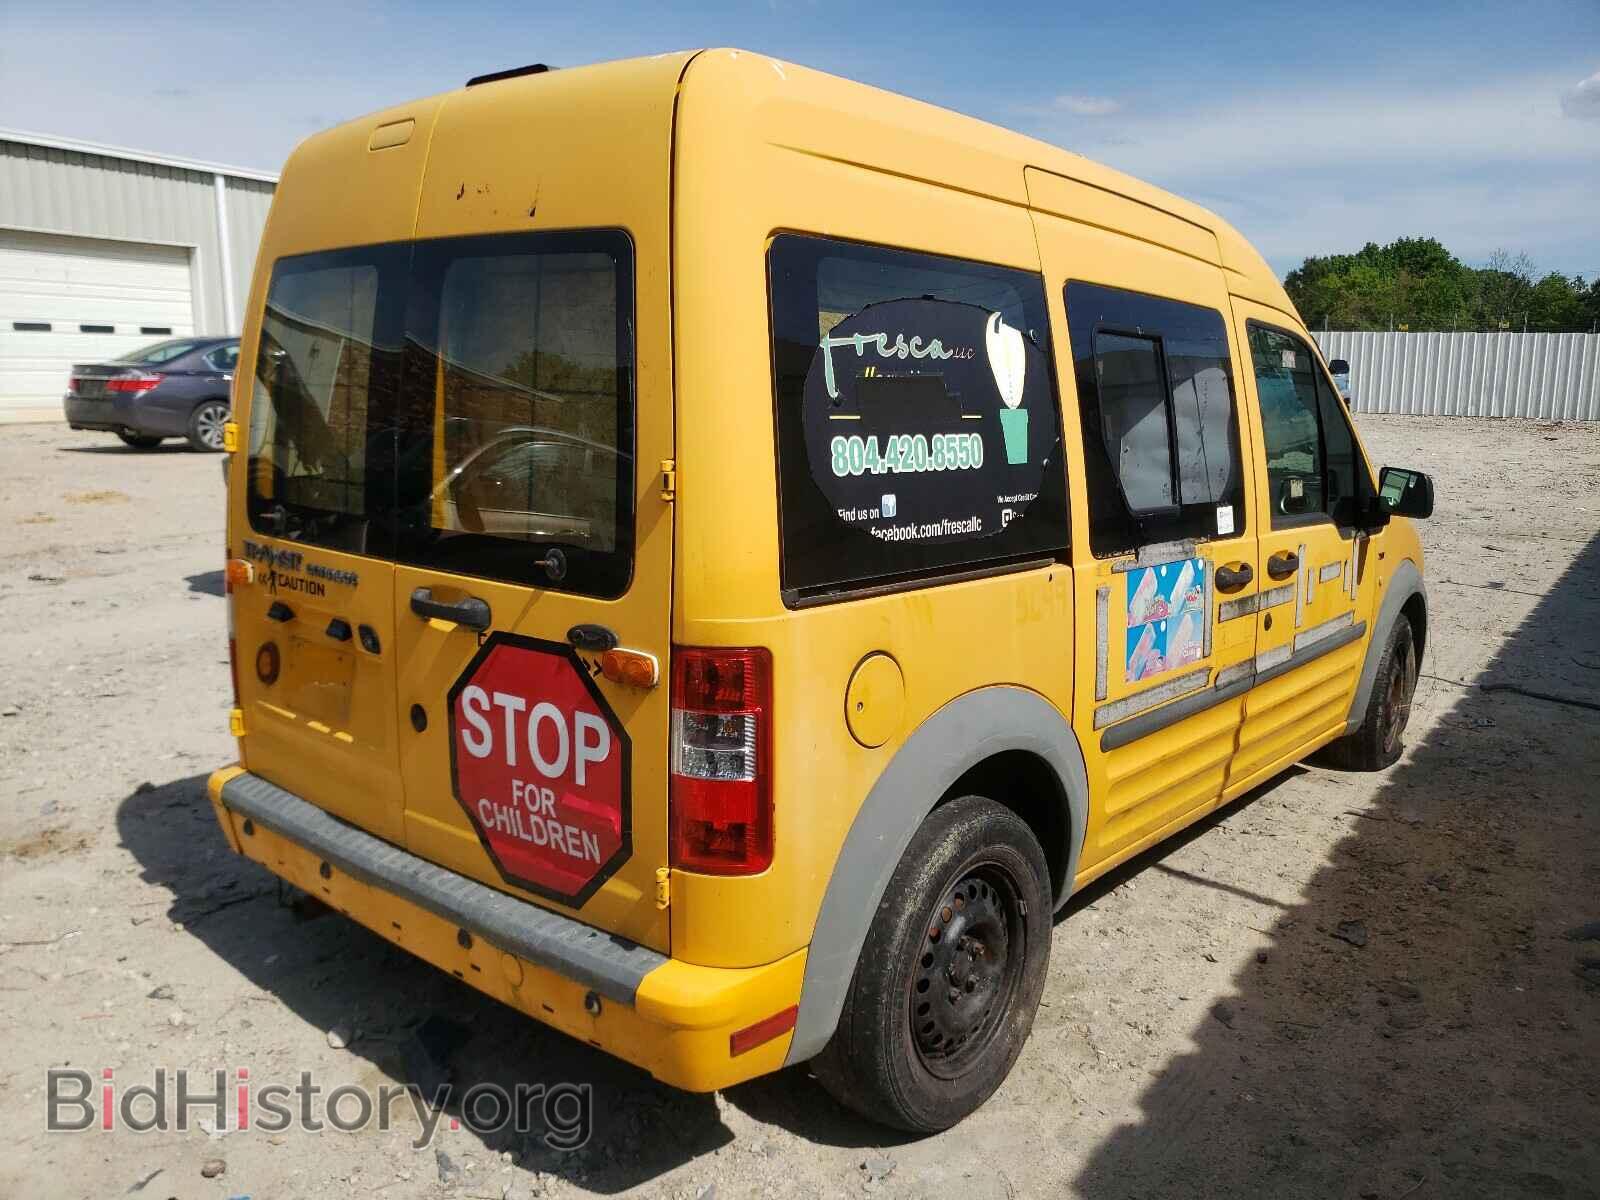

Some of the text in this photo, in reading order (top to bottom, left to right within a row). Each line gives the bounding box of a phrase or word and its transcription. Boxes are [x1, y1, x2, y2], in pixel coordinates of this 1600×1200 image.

[830, 433, 983, 477] 804.420.8550
[837, 507, 856, 521] Find
[857, 509, 868, 520] us
[869, 508, 880, 519] on
[870, 515, 983, 541] facebook.com/frescallc
[278, 573, 326, 597] CAUTION
[461, 685, 611, 786] STOP
[511, 778, 557, 818] FOR
[477, 798, 601, 864] CHILDREN
